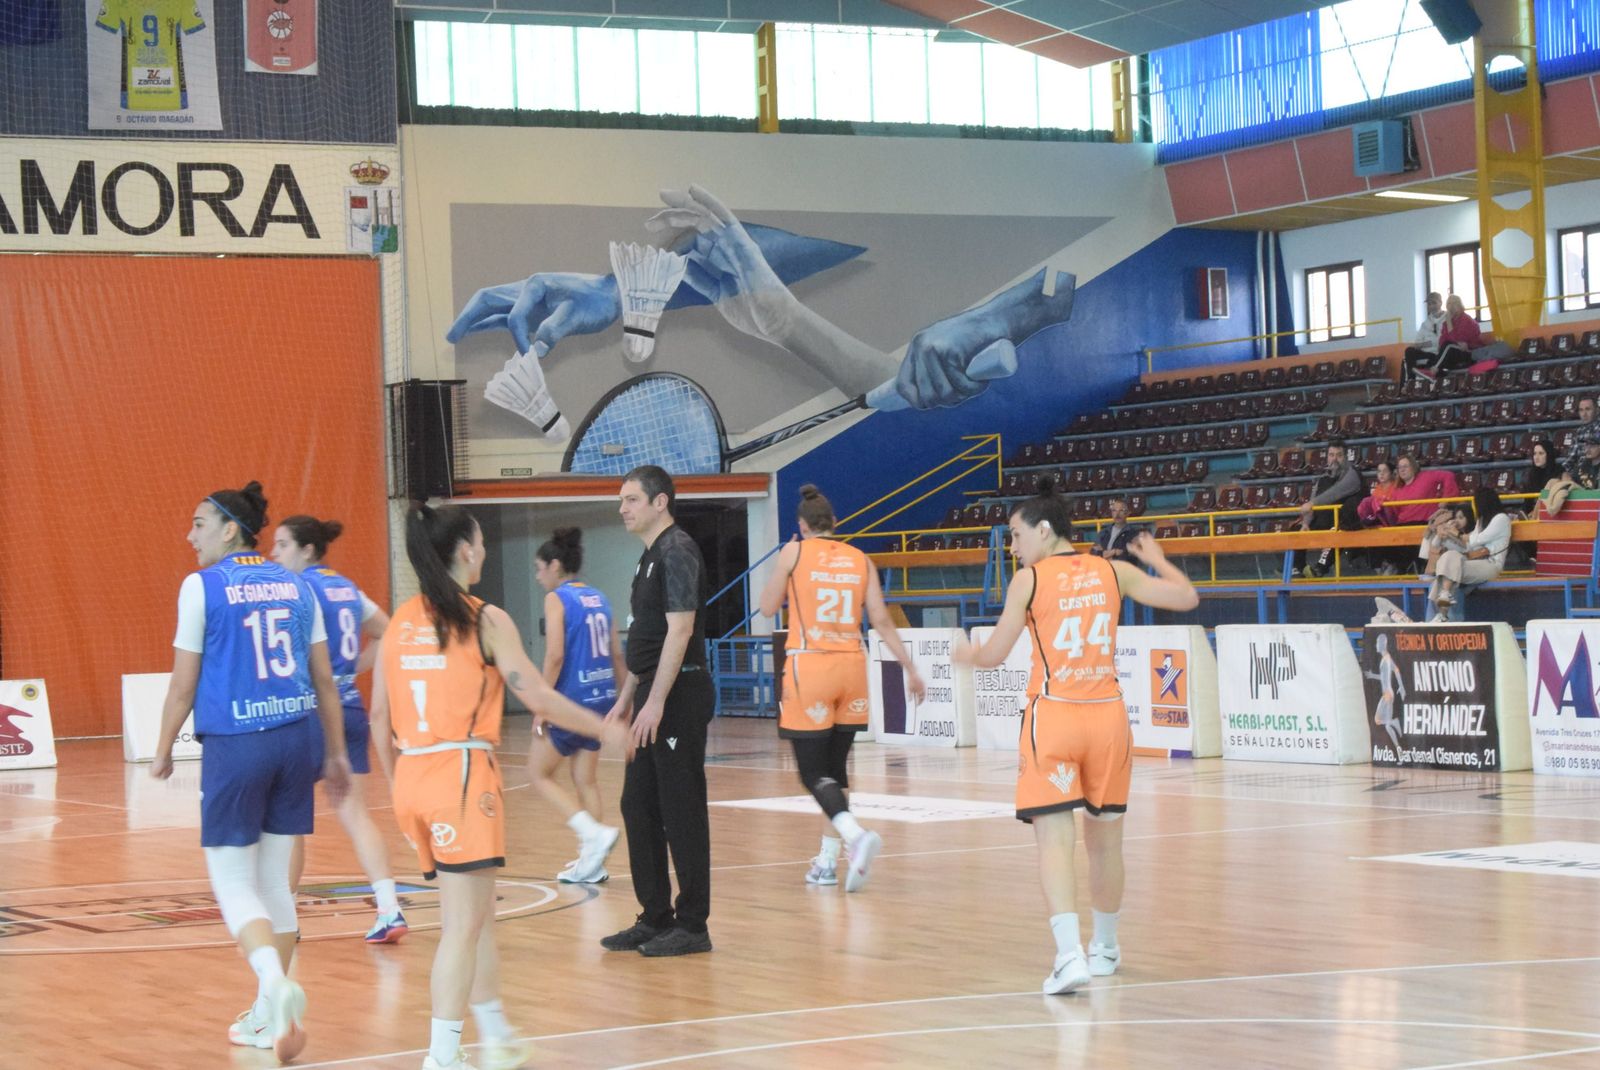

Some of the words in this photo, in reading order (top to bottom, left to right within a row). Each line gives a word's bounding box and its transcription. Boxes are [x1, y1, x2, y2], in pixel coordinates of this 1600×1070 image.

[142, 15, 159, 47] 9
[0, 159, 321, 239] MORA
[244, 582, 300, 603] GIACOMO
[815, 587, 855, 625] 21
[1058, 592, 1107, 611] CASTRO
[243, 608, 297, 680] 15
[338, 607, 359, 661] 8
[585, 612, 610, 658] 10
[919, 640, 932, 656] LUIS
[933, 640, 951, 656] FELIPE
[1053, 612, 1112, 659] 44
[1427, 634, 1435, 651] Y
[1436, 633, 1488, 651] ORTOPEDIA
[1413, 660, 1476, 692] ANTONIO
[231, 691, 318, 720] Limitronic
[409, 680, 429, 732] 1
[976, 695, 1022, 717] MARTA
[1403, 696, 1488, 736] HERNÁNDEZ
[919, 720, 955, 738] ABOGADO
[1229, 714, 1302, 734] HERBI-PLAST,
[1306, 715, 1328, 732] S.L.
[1230, 734, 1330, 749] SEÑALIZACIONES
[1373, 745, 1397, 762] Avda.
[1435, 747, 1482, 768] Cisneros,
[1484, 749, 1496, 766] 21
